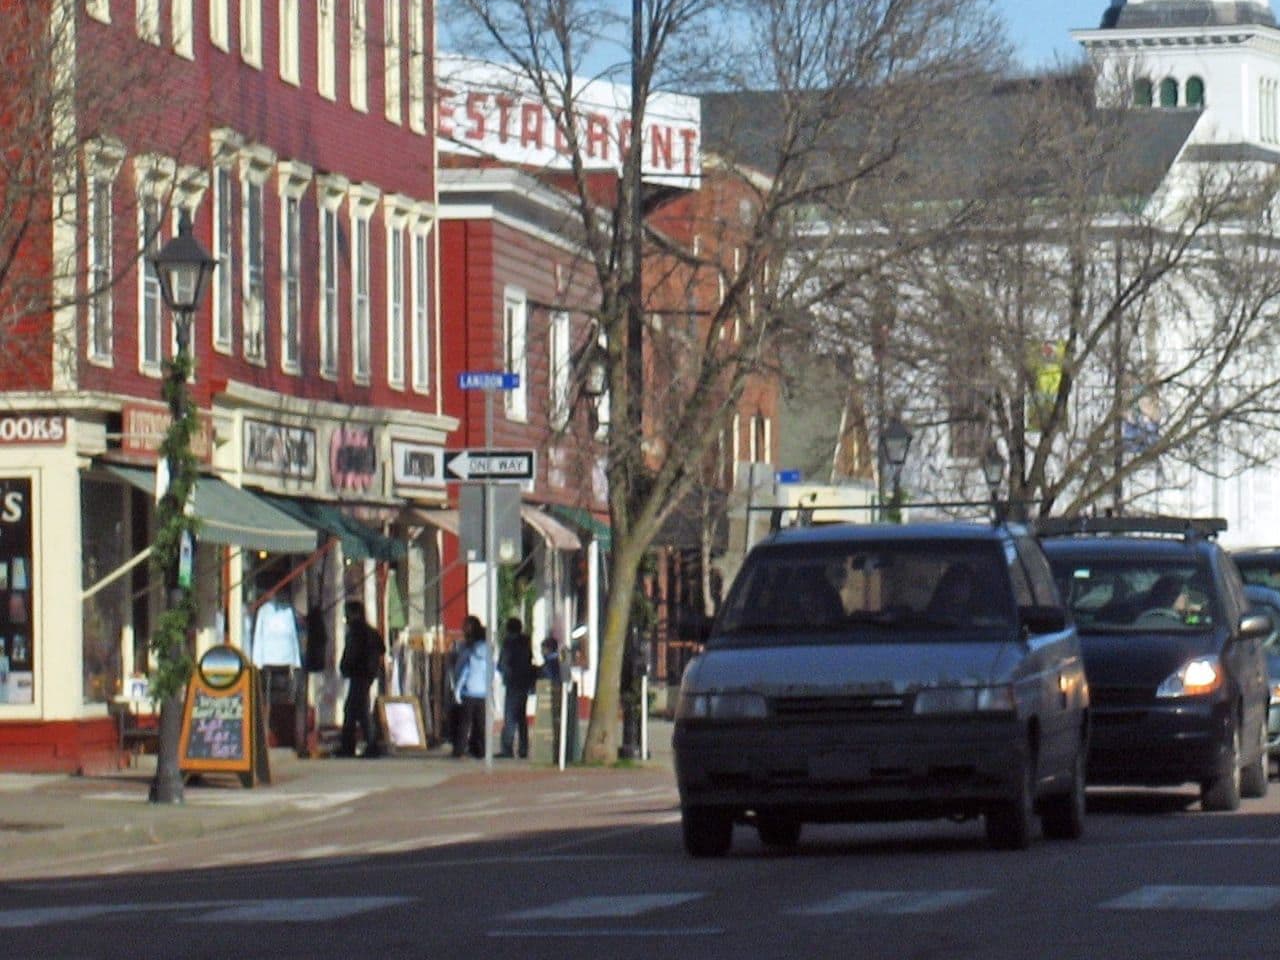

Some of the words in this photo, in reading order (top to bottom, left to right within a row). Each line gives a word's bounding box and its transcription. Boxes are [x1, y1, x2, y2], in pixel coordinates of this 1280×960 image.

[0, 417, 64, 440] OOKS
[470, 459, 490, 470] ONE
[499, 459, 523, 470] WAY
